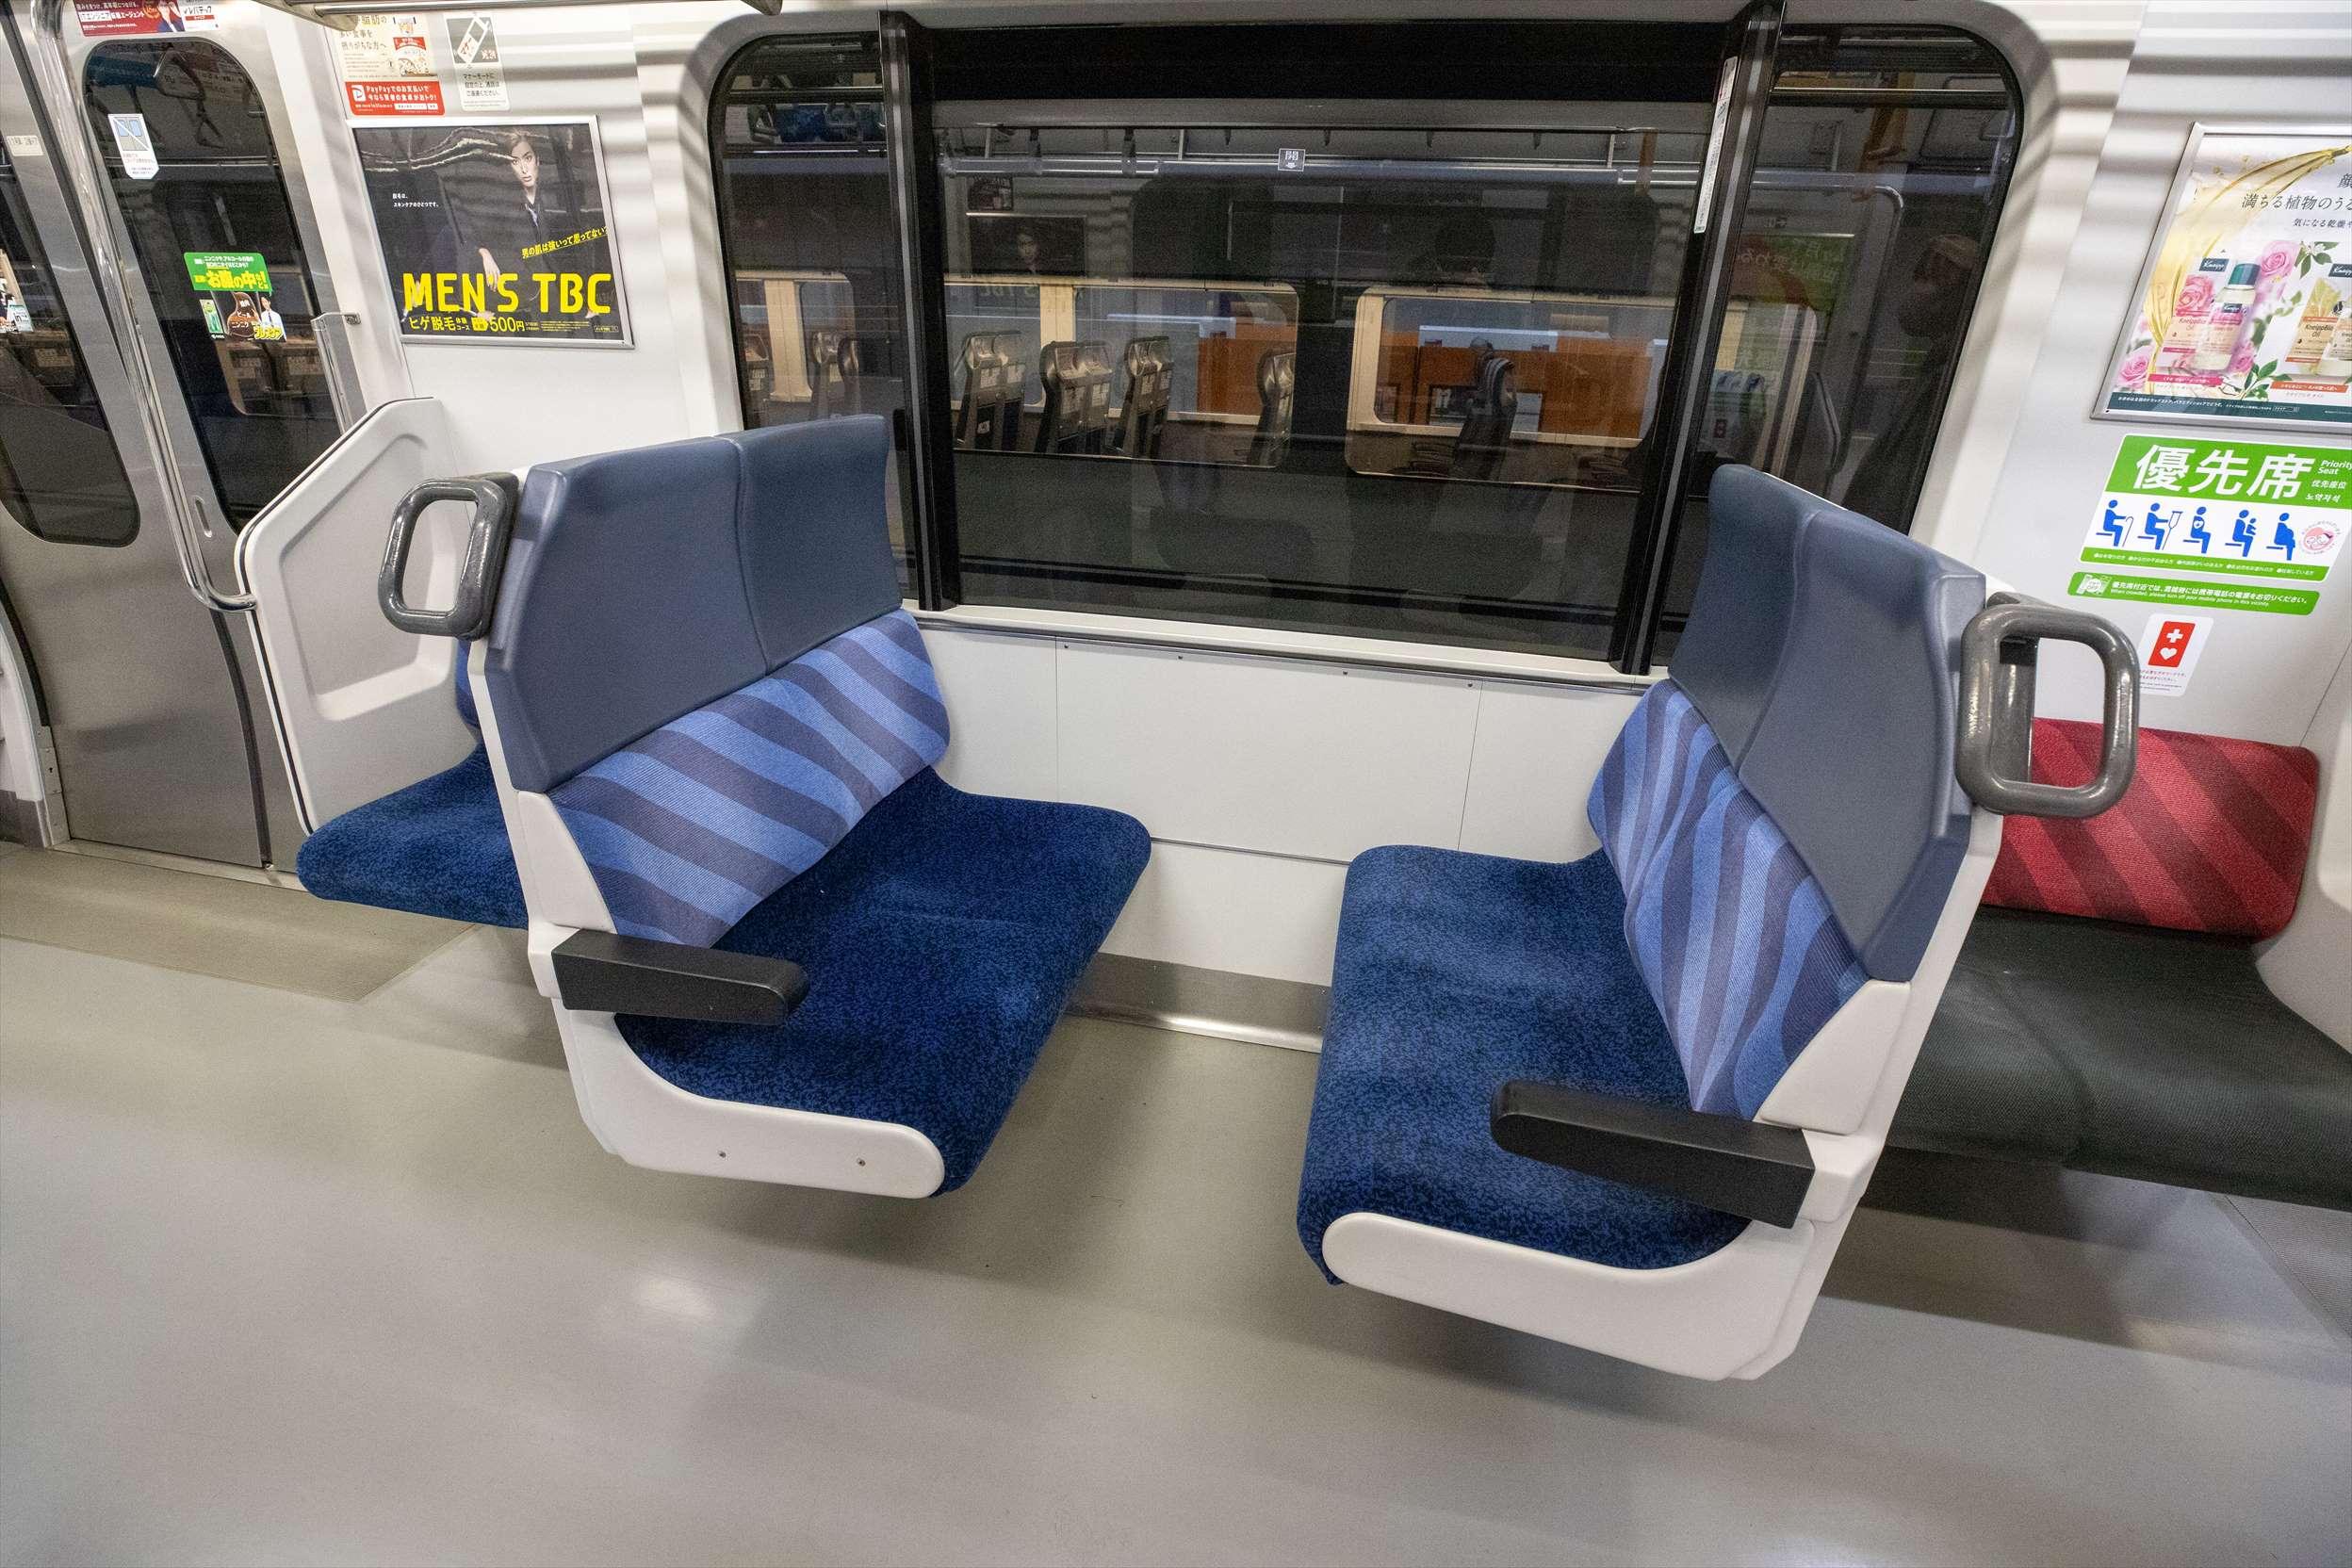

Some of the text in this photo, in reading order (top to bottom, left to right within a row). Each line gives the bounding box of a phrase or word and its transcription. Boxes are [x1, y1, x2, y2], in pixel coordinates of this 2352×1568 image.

[402, 272, 612, 314] MEN'S TBC
[409, 317, 456, 331] ヒゲ脱毛
[490, 317, 525, 332] 500円
[2133, 444, 2315, 499] 優先席
[2321, 459, 2352, 470] Priority
